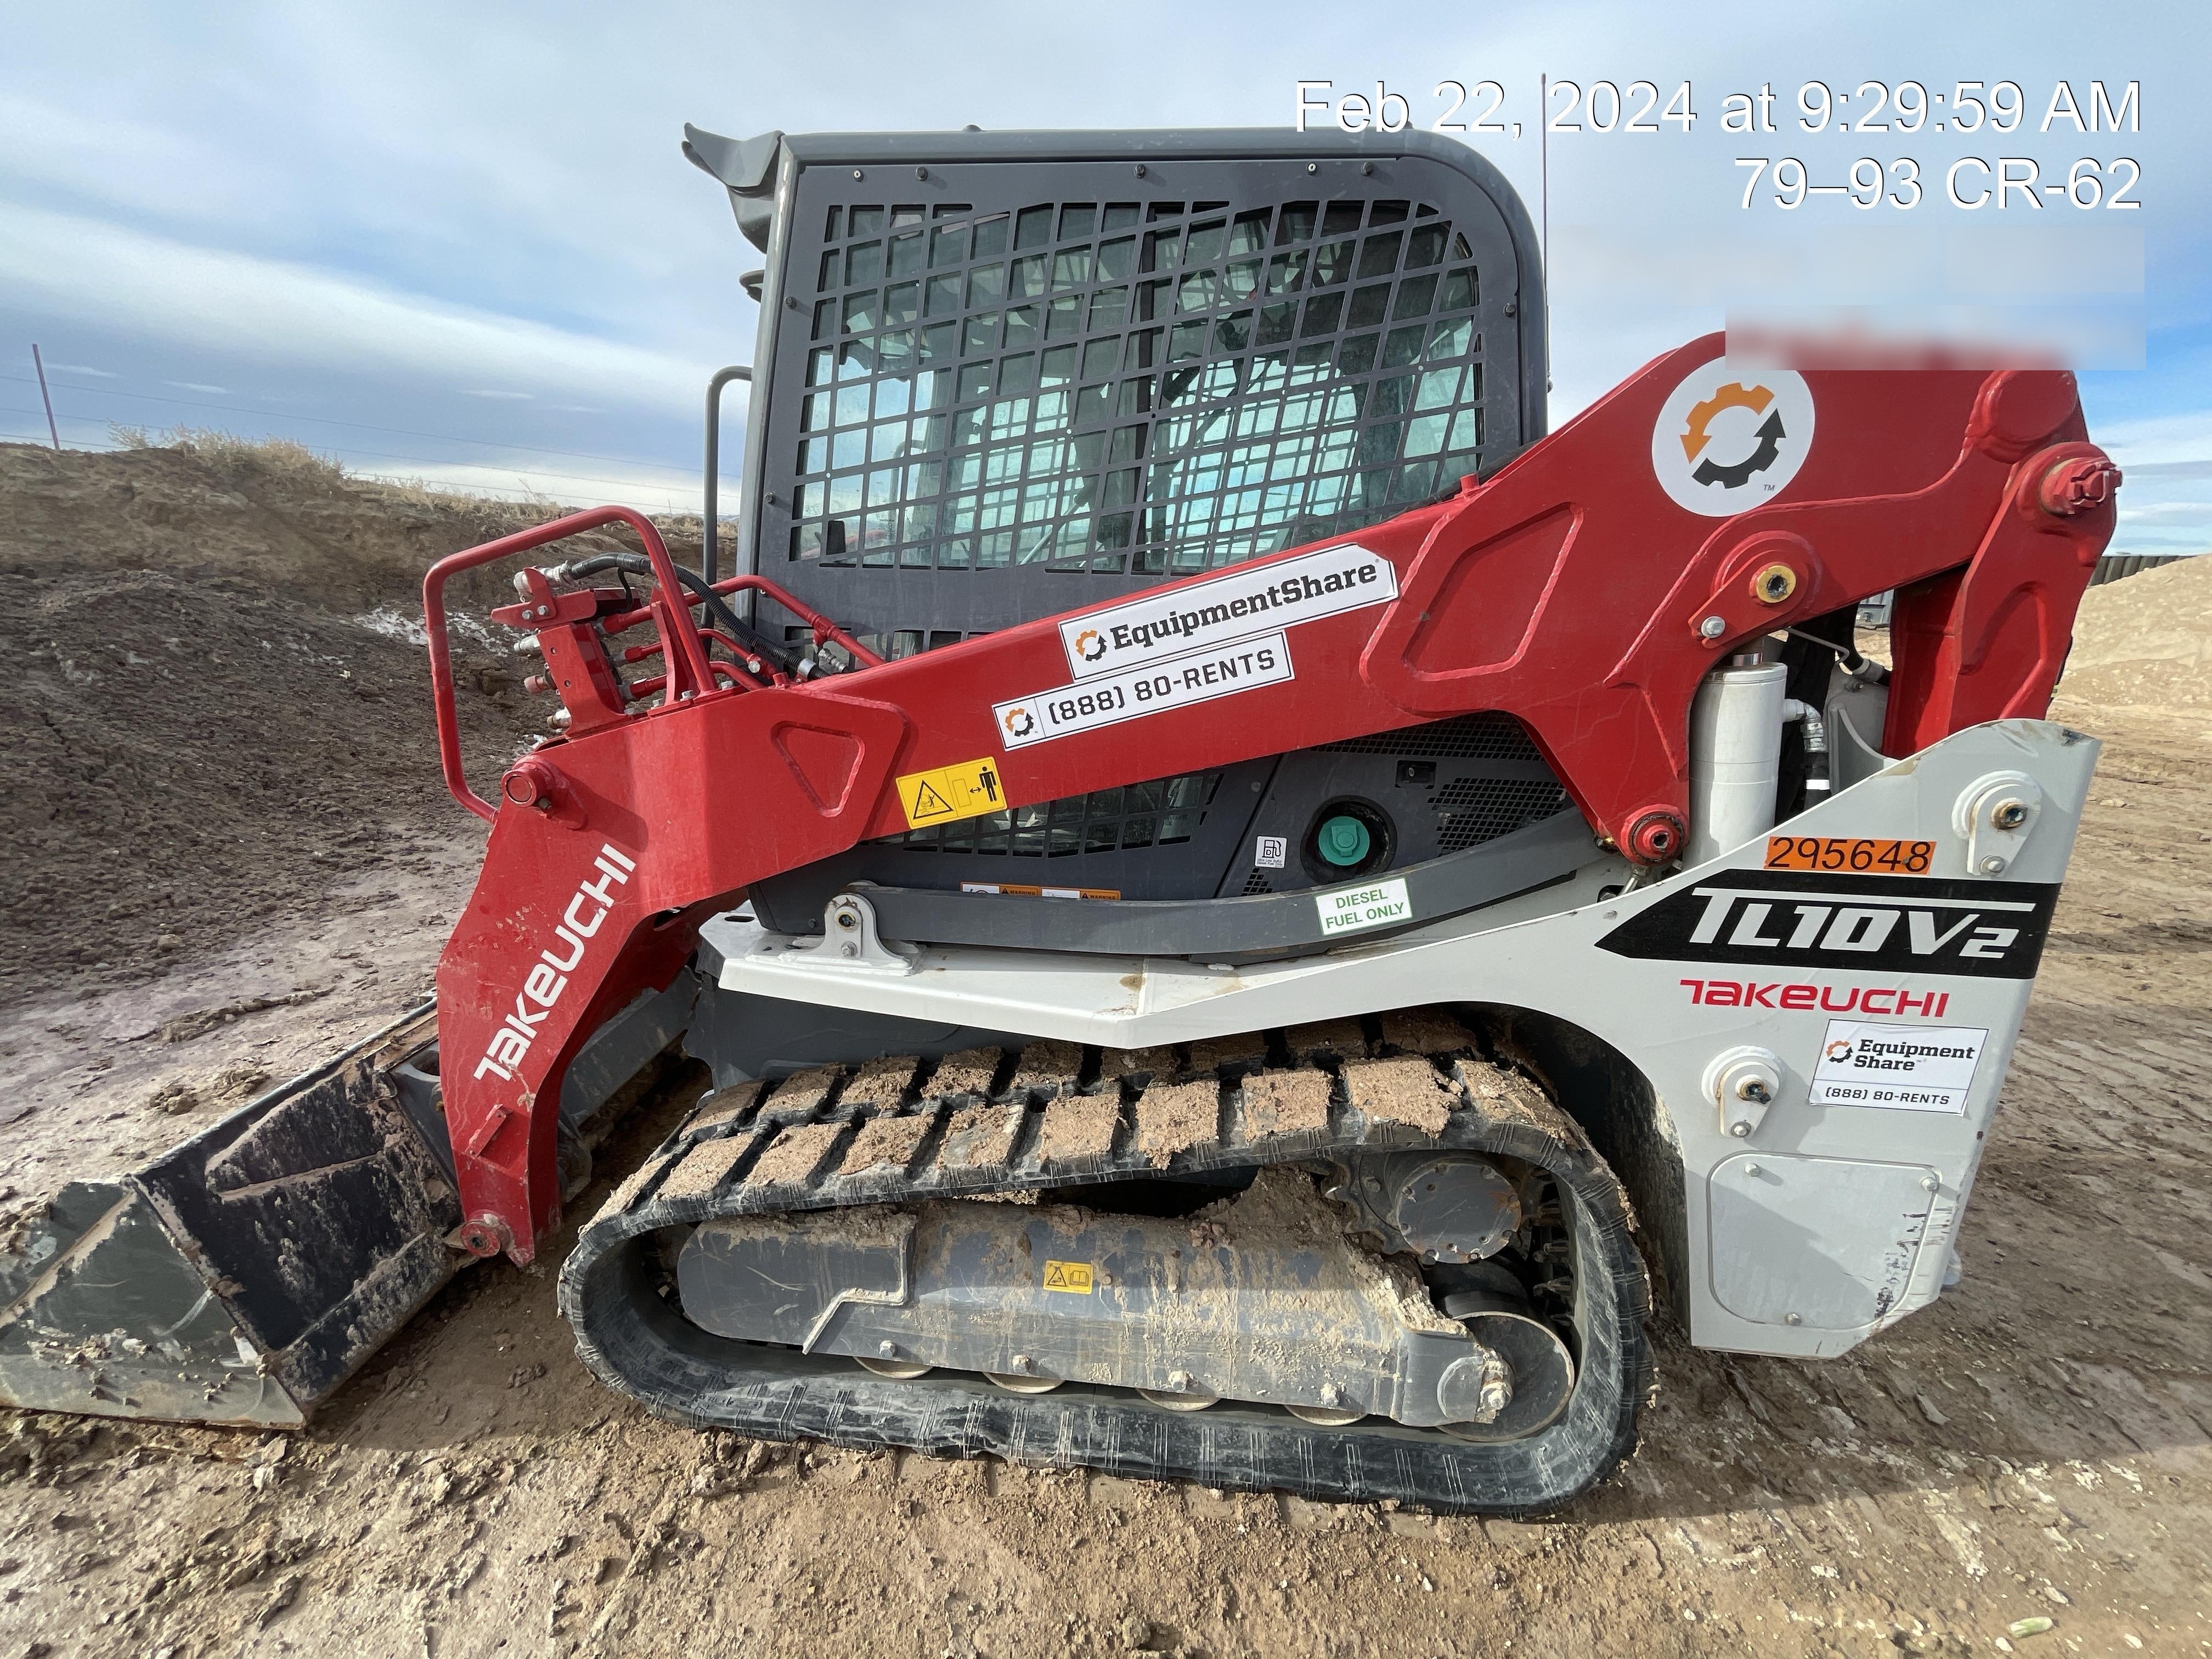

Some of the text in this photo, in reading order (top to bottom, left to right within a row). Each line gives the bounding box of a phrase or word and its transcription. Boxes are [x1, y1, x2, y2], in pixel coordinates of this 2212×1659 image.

[1109, 563, 1377, 650] EquipmentShare
[1048, 648, 1276, 725] (888) 80-RENTS
[1768, 837, 1931, 873] 295648
[1335, 889, 1388, 909] DIESEL
[1325, 902, 1404, 929] FUEL ONLY
[1689, 887, 2036, 959] TL10V2
[1858, 1039, 1975, 1059] Equipment
[1854, 1055, 1915, 1071] Share
[1825, 1087, 1950, 1105] (888) 80-RENTS
